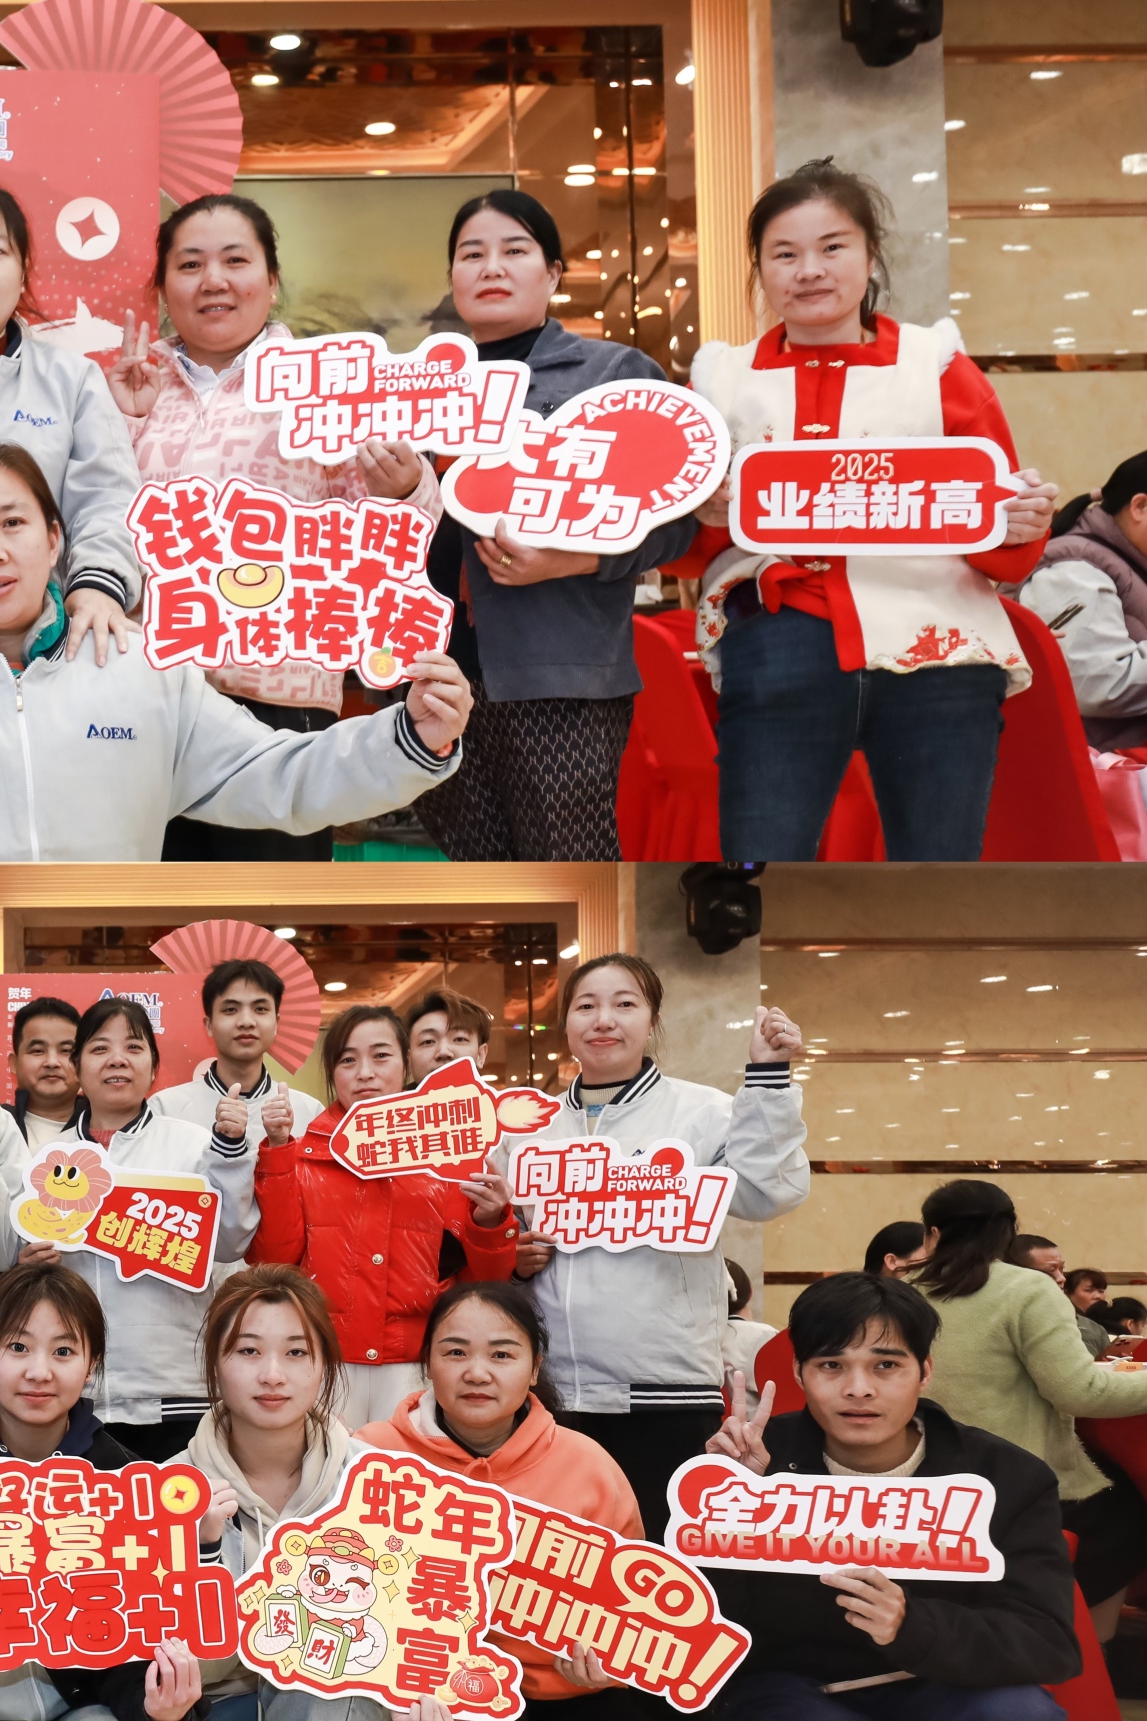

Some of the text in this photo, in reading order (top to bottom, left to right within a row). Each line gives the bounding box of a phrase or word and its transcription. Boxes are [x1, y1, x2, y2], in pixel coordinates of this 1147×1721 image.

[259, 341, 372, 400] 向前
[374, 358, 453, 377] CHARGE
[374, 373, 471, 393] FORWARD
[582, 390, 716, 513] ACHIEVEMENT
[830, 452, 895, 481] 2025
[508, 477, 642, 541] 可为
[757, 479, 983, 530] 业绩新高
[137, 486, 425, 573] 钱包胖胖
[154, 576, 444, 668] 身体棒棒
[8, 986, 32, 1000] 贺年
[355, 1097, 481, 1138] 年终冲刺
[356, 1127, 485, 1168] 蛇我其谁
[518, 1146, 607, 1196] 向前
[607, 1164, 672, 1178] CHARGE
[607, 1177, 687, 1193] FORWARD
[126, 1192, 202, 1239] 2025
[96, 1211, 201, 1275] 创辉煌
[359, 1468, 496, 1554] 蛇年
[681, 1528, 983, 1567] GIVE IT YOUR ALL
[624, 1559, 694, 1617] GO
[273, 1609, 294, 1636] 發
[396, 1554, 472, 1695] 暴富
[307, 1639, 335, 1665] 財
